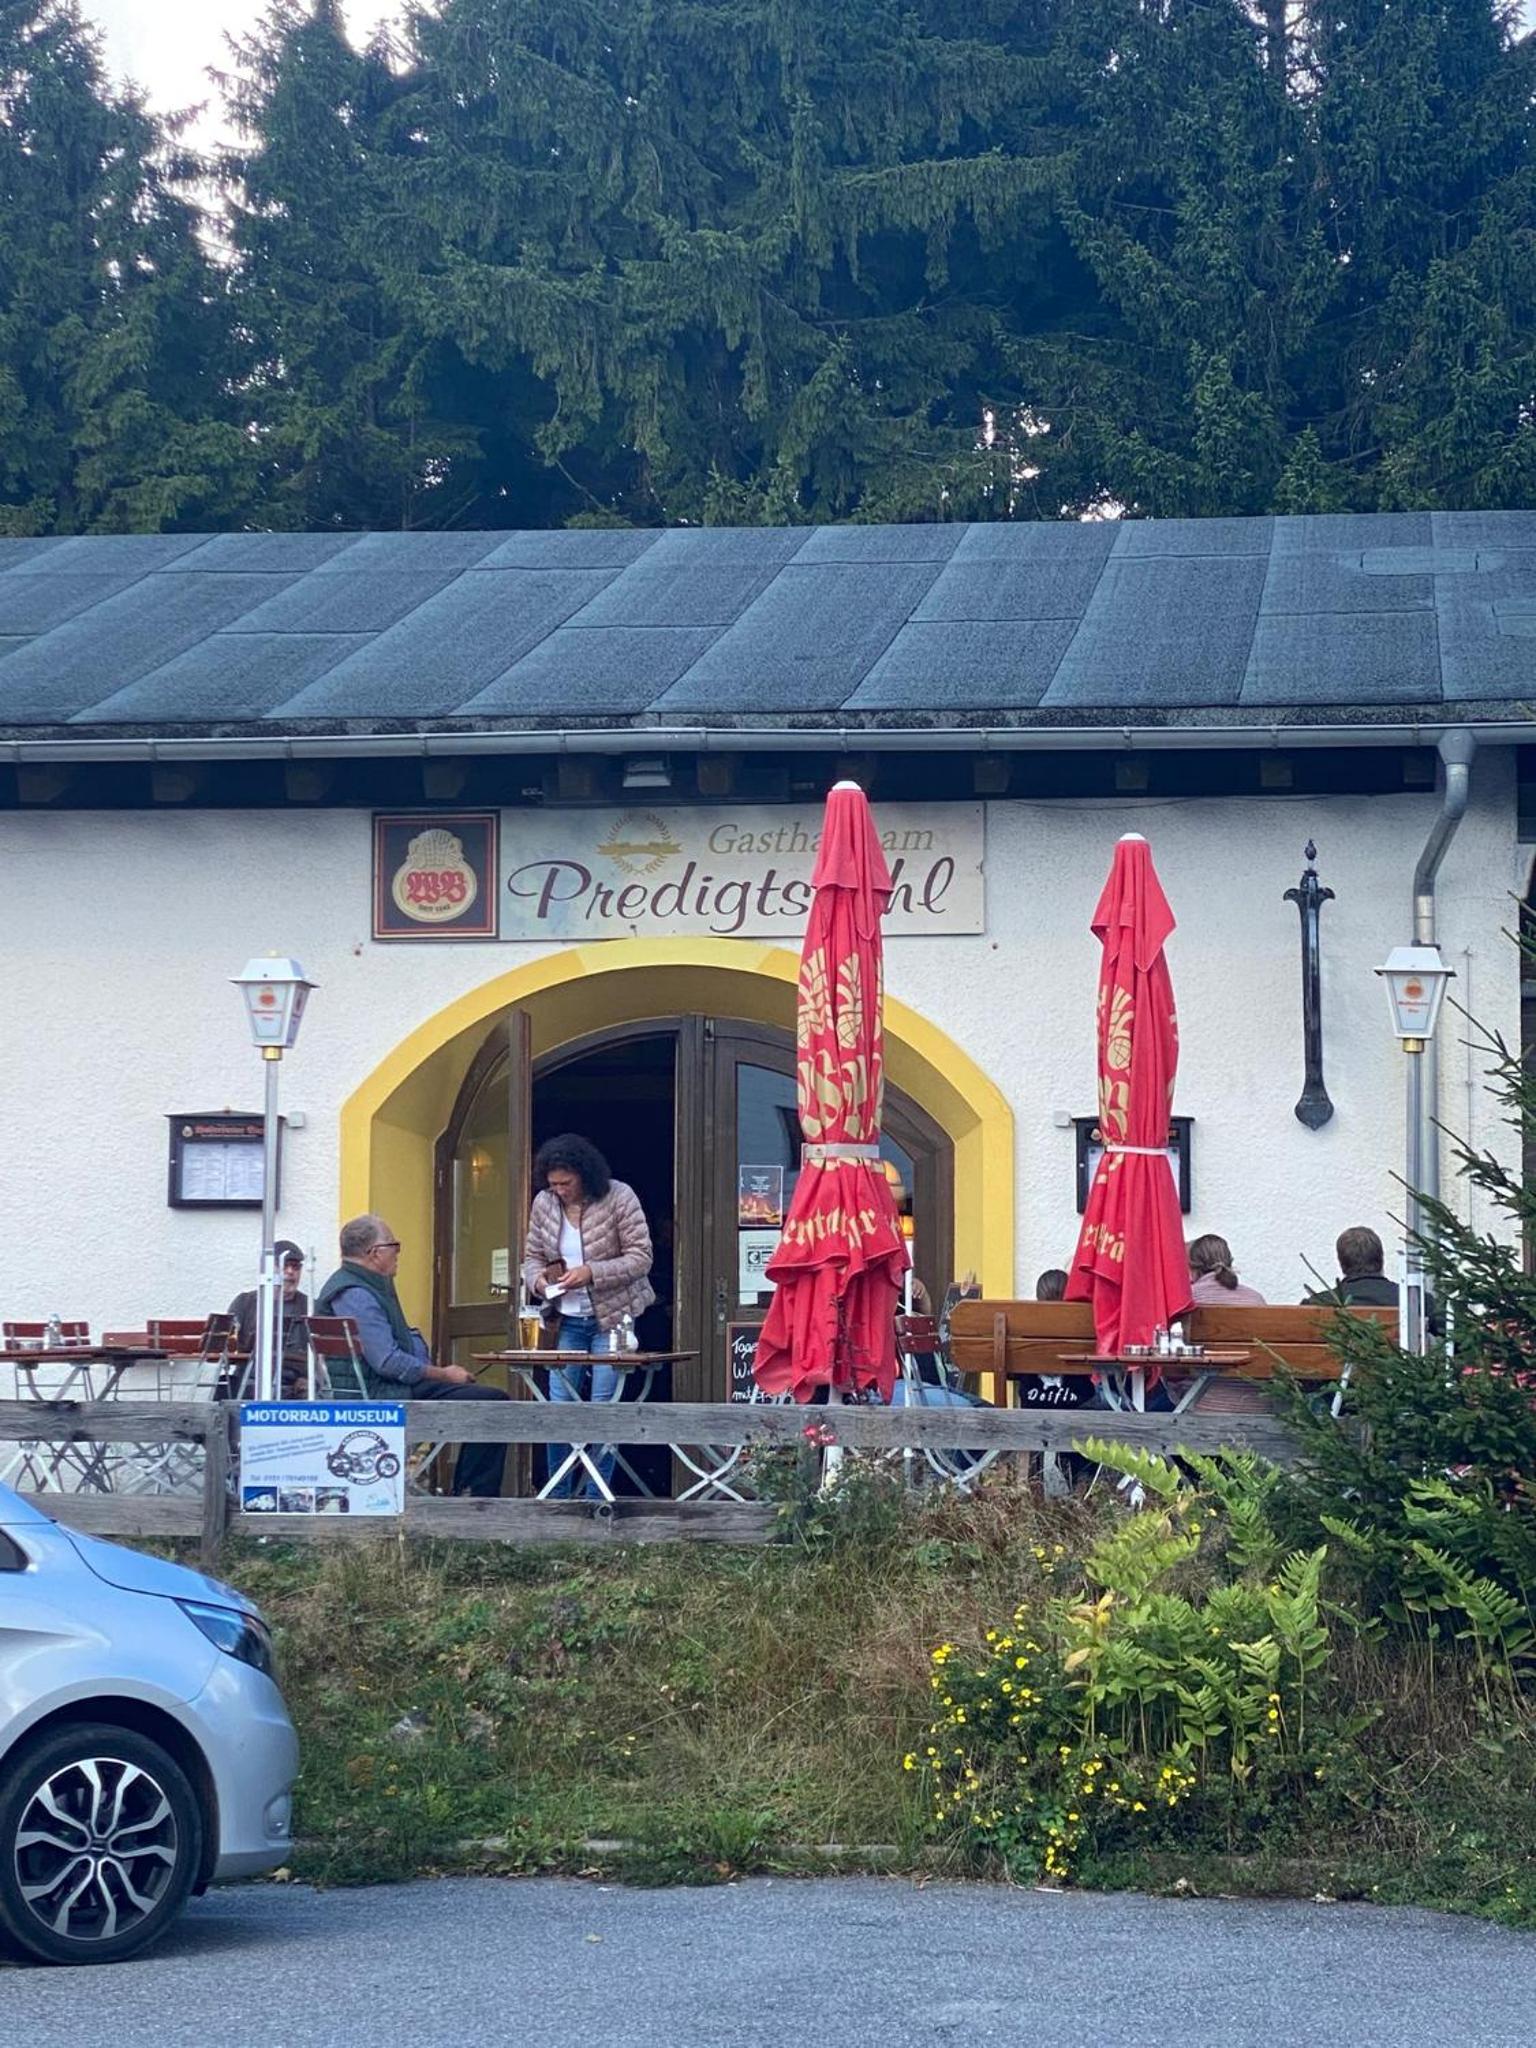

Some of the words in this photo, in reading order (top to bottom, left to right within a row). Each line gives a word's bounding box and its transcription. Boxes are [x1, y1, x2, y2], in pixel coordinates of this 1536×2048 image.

[882, 827, 934, 851] am
[507, 857, 954, 934] Predigtshl
[246, 1409, 330, 1423] MOTORRAD
[334, 1409, 399, 1423] MUSEUM
